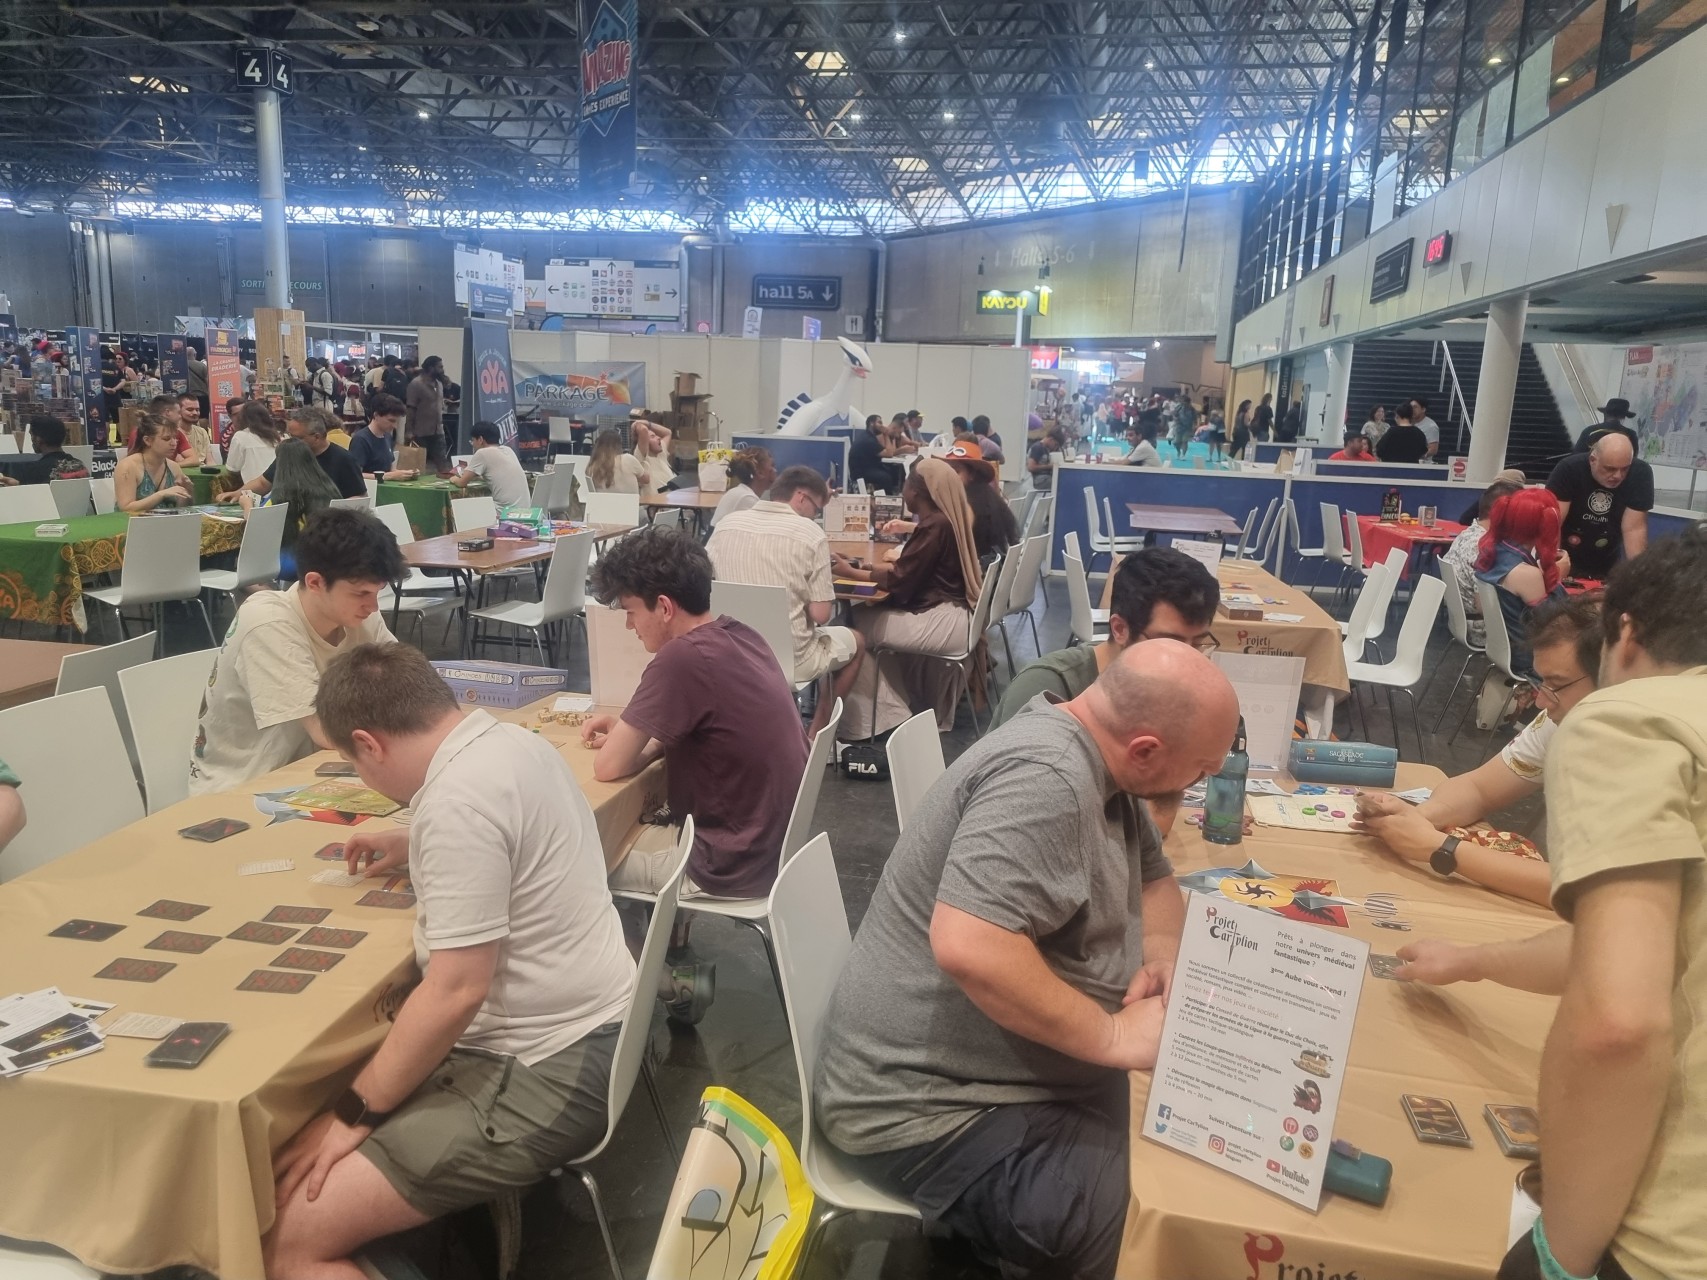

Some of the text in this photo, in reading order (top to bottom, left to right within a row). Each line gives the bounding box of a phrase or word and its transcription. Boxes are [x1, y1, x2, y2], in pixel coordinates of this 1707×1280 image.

[244, 58, 262, 82] 4
[277, 64, 288, 88] 4
[581, 40, 632, 96] AMAZING
[599, 90, 629, 111] EXPERIENCE
[1010, 244, 1076, 267] Halls 5-6
[241, 280, 322, 290] SORTI ECOURS
[759, 286, 814, 299] hall 5A
[982, 296, 1028, 309] KAYOU
[481, 360, 509, 394] OYA
[525, 383, 609, 401] PARKAGE
[92, 460, 117, 472] Black
[1237, 630, 1268, 647] Projet
[848, 762, 878, 774] FILA
[1205, 906, 1235, 932] Projet
[1277, 930, 1293, 941] Prêts
[1309, 941, 1334, 952] plonger
[1340, 950, 1356, 960] dans
[1273, 948, 1310, 965] fantastique
[1275, 941, 1355, 969] notre univers médiéval
[1208, 972, 1233, 984] fantastique
[1284, 972, 1301, 982] Aube
[1303, 979, 1318, 988] vous
[1184, 982, 1201, 992] Venez
[1232, 998, 1245, 1007] jeux
[1256, 1007, 1279, 1018] société
[1175, 1084, 1192, 1094] jouers
[1172, 1112, 1186, 1122] Projet
[1208, 1114, 1224, 1125] Suivez
[1225, 1121, 1251, 1136] l'aventure
[1266, 1172, 1281, 1184] Projet
[1281, 1164, 1309, 1186] YouTube
[1244, 1232, 1358, 1280] Proj
